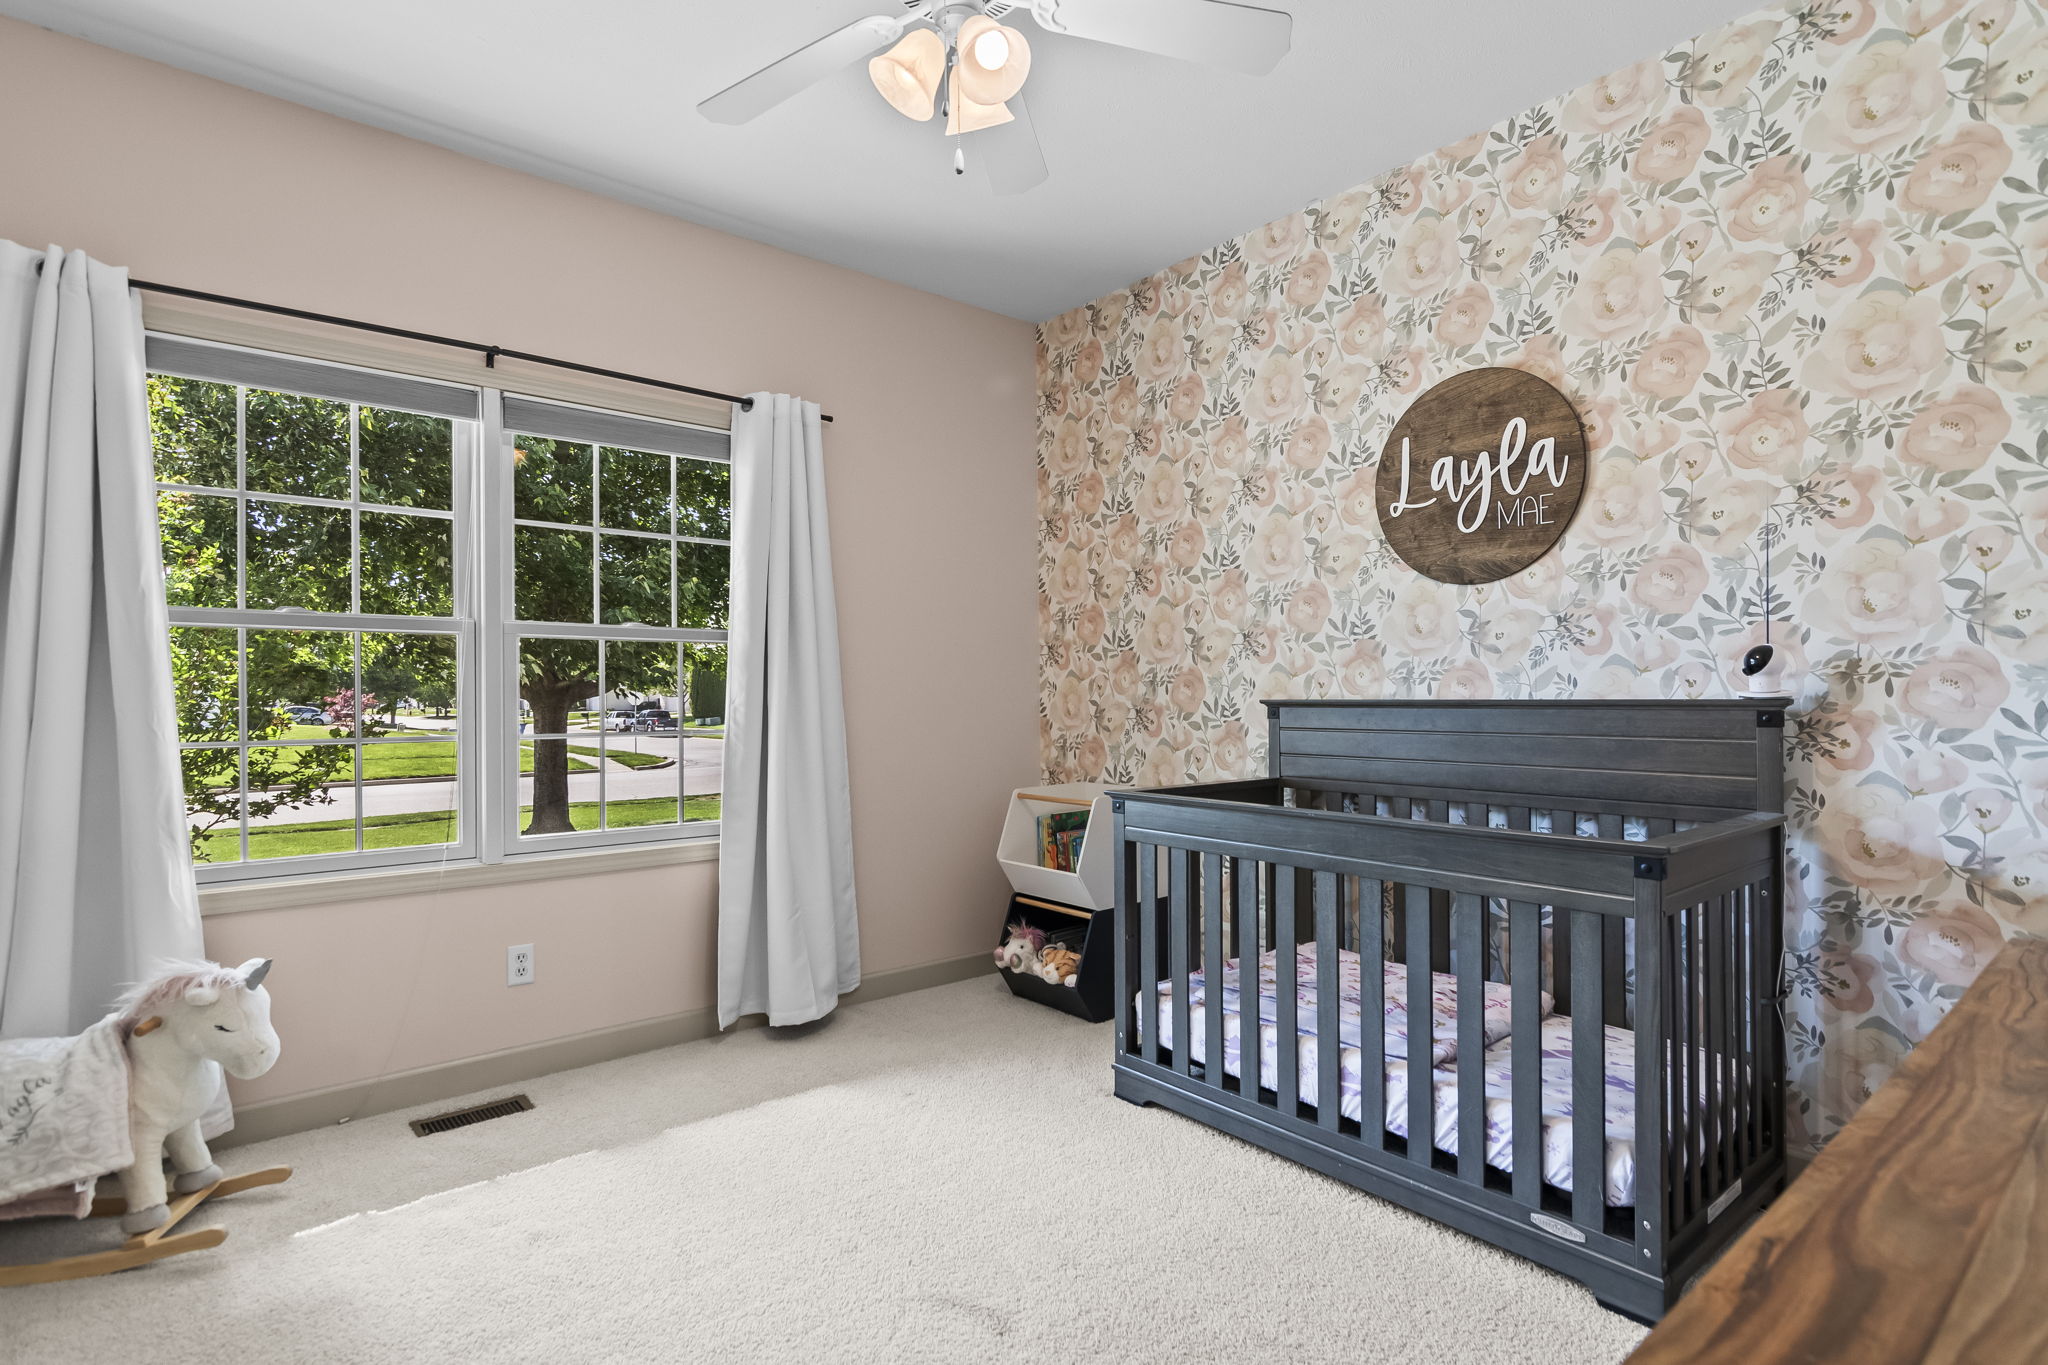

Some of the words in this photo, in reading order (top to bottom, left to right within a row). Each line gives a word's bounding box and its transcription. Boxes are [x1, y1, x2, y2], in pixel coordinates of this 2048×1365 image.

[1389, 416, 1569, 534] Layla
[1497, 493, 1555, 529] MAE
[0, 1076, 53, 1130] ayla
